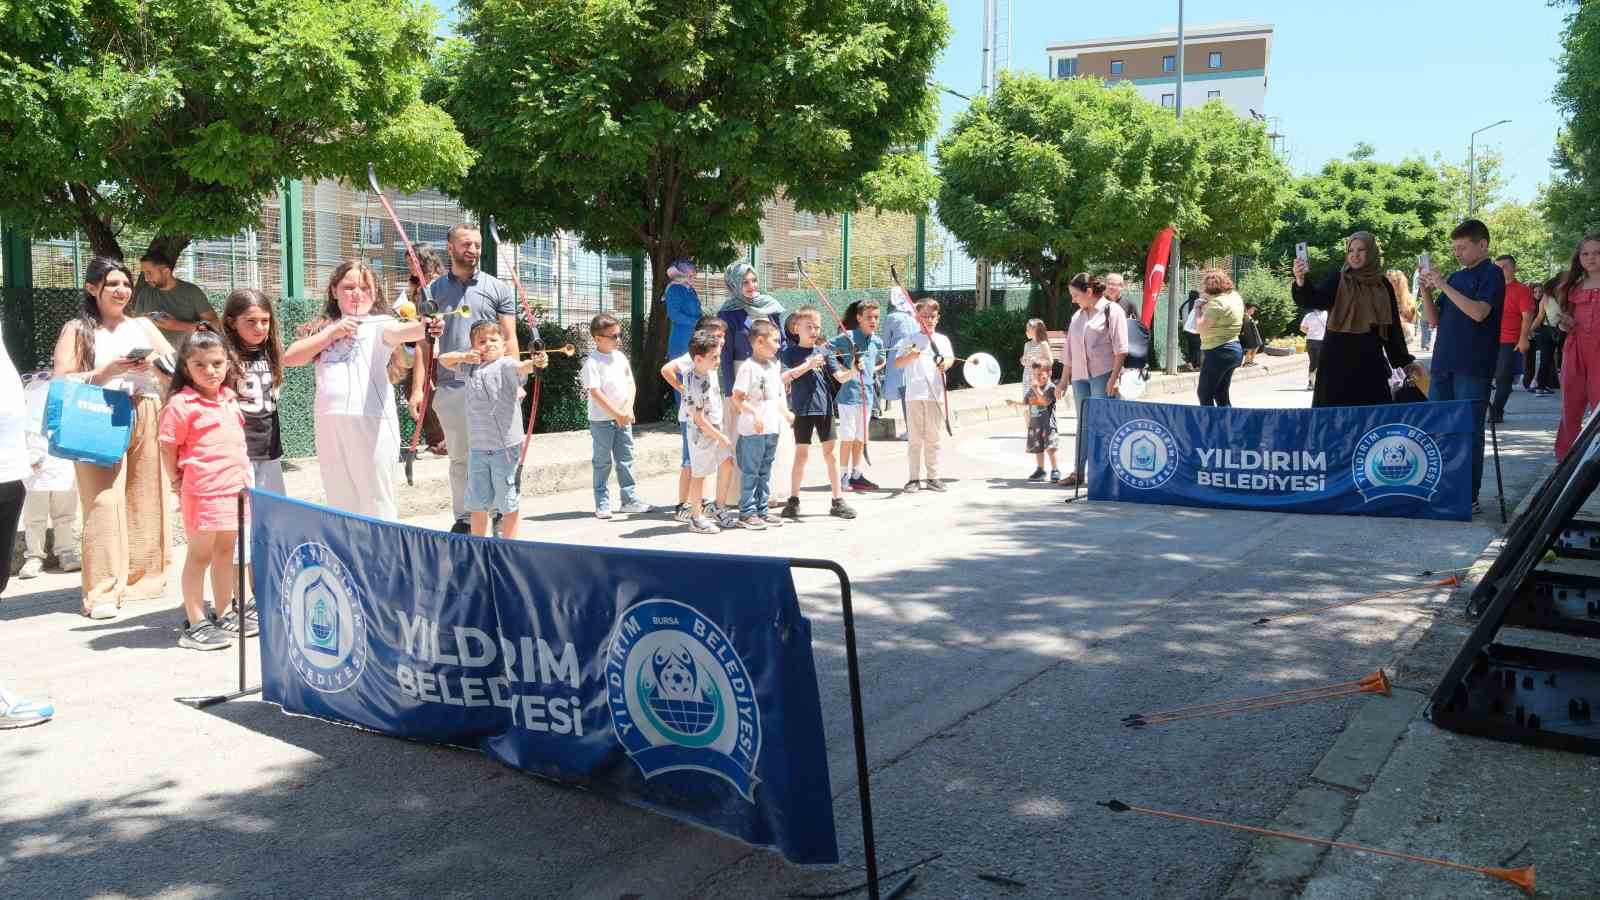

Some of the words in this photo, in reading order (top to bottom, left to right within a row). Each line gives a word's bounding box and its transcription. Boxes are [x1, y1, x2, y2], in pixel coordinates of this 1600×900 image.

[1196, 447, 1327, 471] YILDIRIM
[652, 616, 680, 625] BURSA
[396, 610, 581, 688] YILDRIM
[610, 615, 642, 735] YILDIRIM
